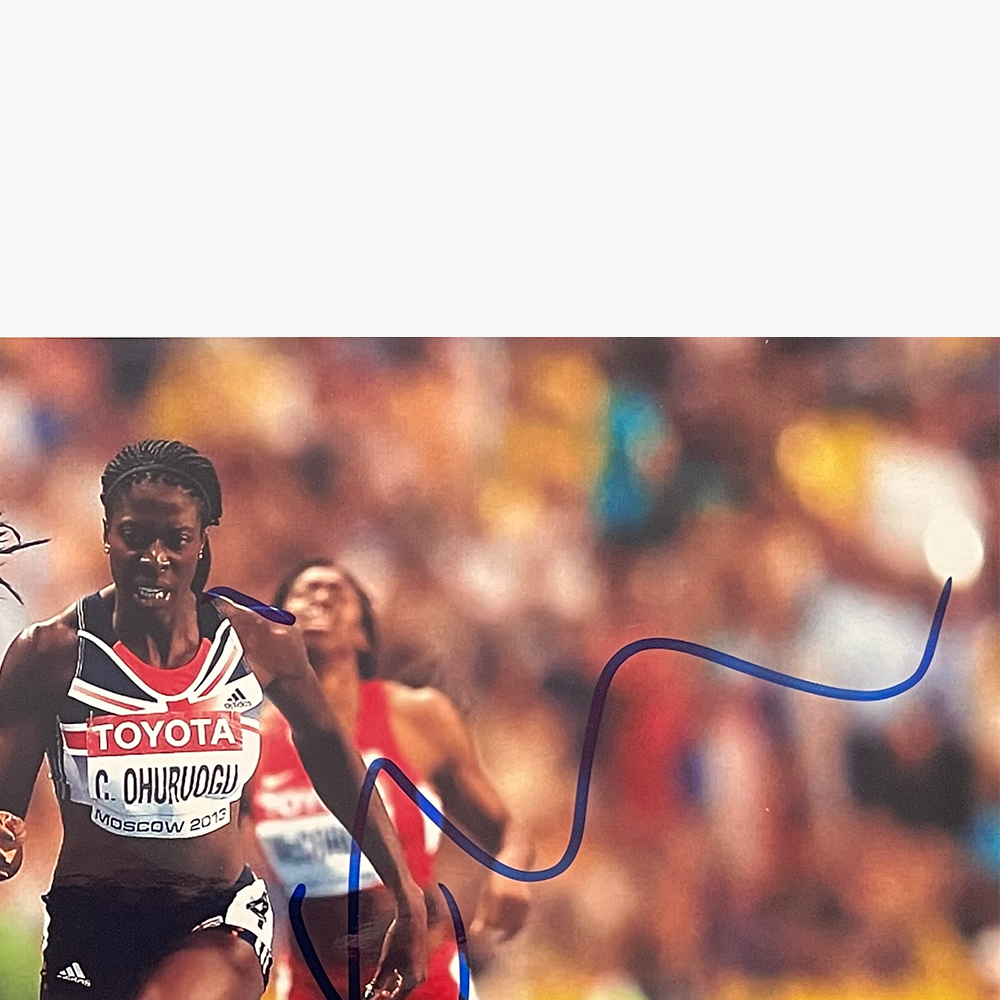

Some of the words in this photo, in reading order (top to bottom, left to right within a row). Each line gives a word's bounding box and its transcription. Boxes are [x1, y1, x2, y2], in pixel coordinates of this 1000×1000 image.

[92, 718, 236, 750] TOYOTA
[95, 769, 116, 801] C.
[124, 764, 239, 805] OHURUOGU
[95, 809, 186, 833] MOSCOW
[190, 808, 227, 831] 2013
